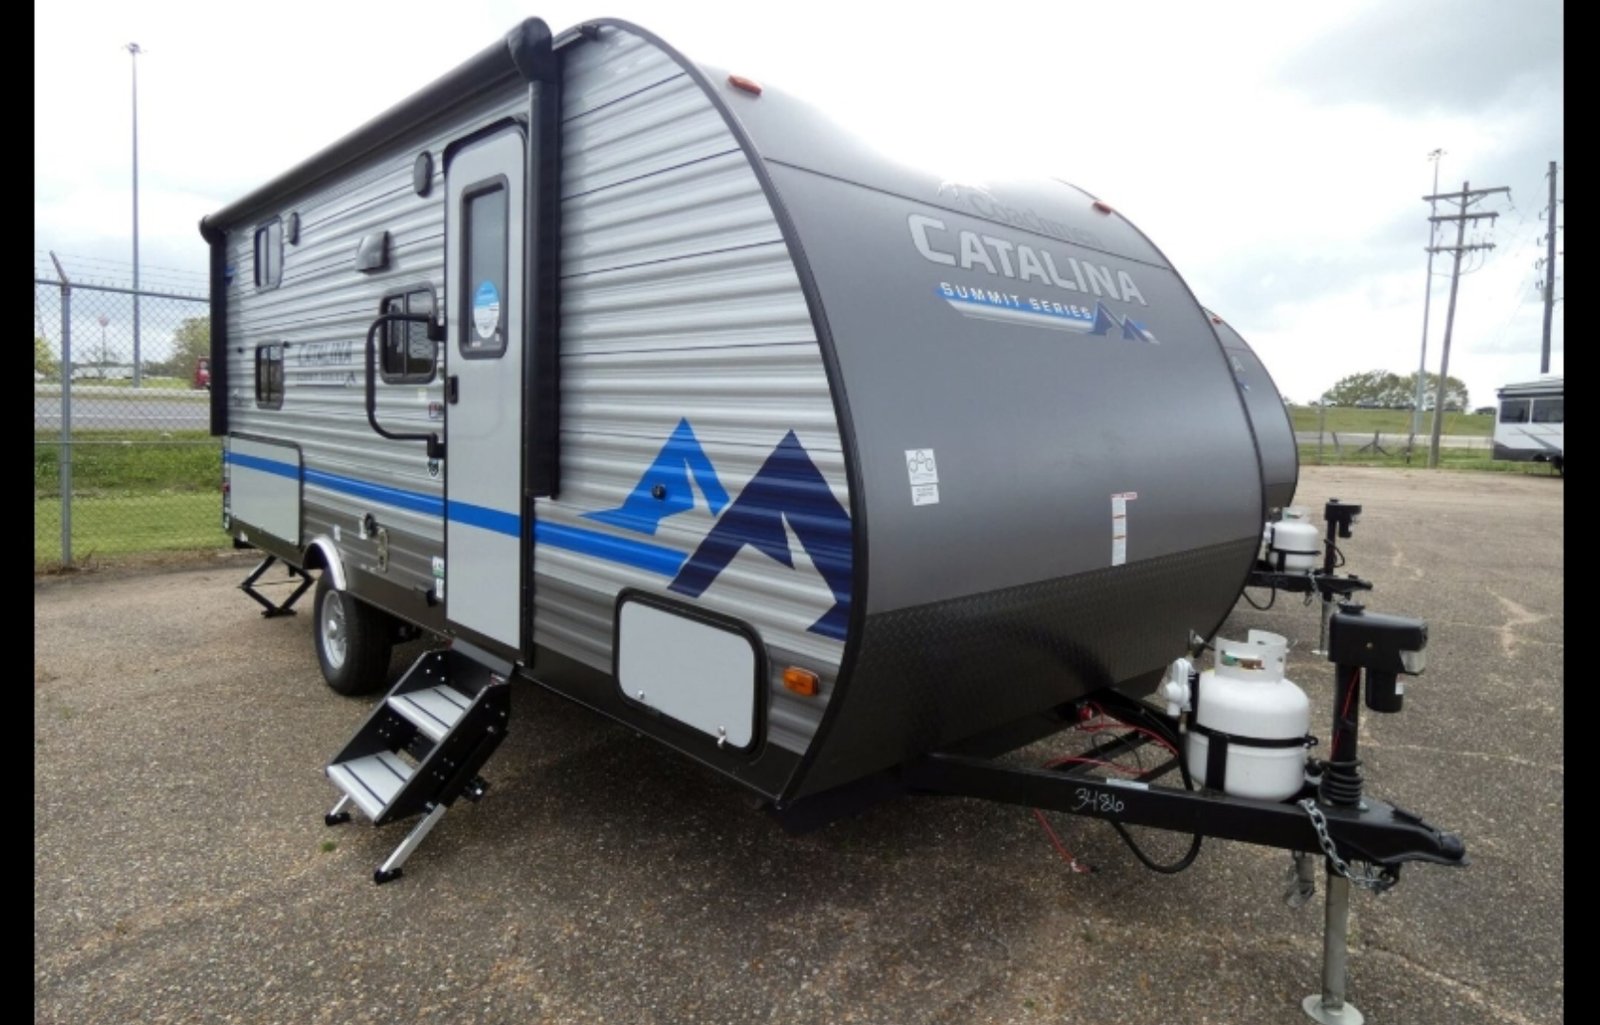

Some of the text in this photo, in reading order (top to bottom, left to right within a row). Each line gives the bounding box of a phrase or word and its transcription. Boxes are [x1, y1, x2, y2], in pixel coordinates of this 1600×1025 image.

[908, 213, 1148, 306] CATALINA
[939, 281, 1093, 320] SUMMIT SERIES
[1071, 787, 1125, 812] 3486
